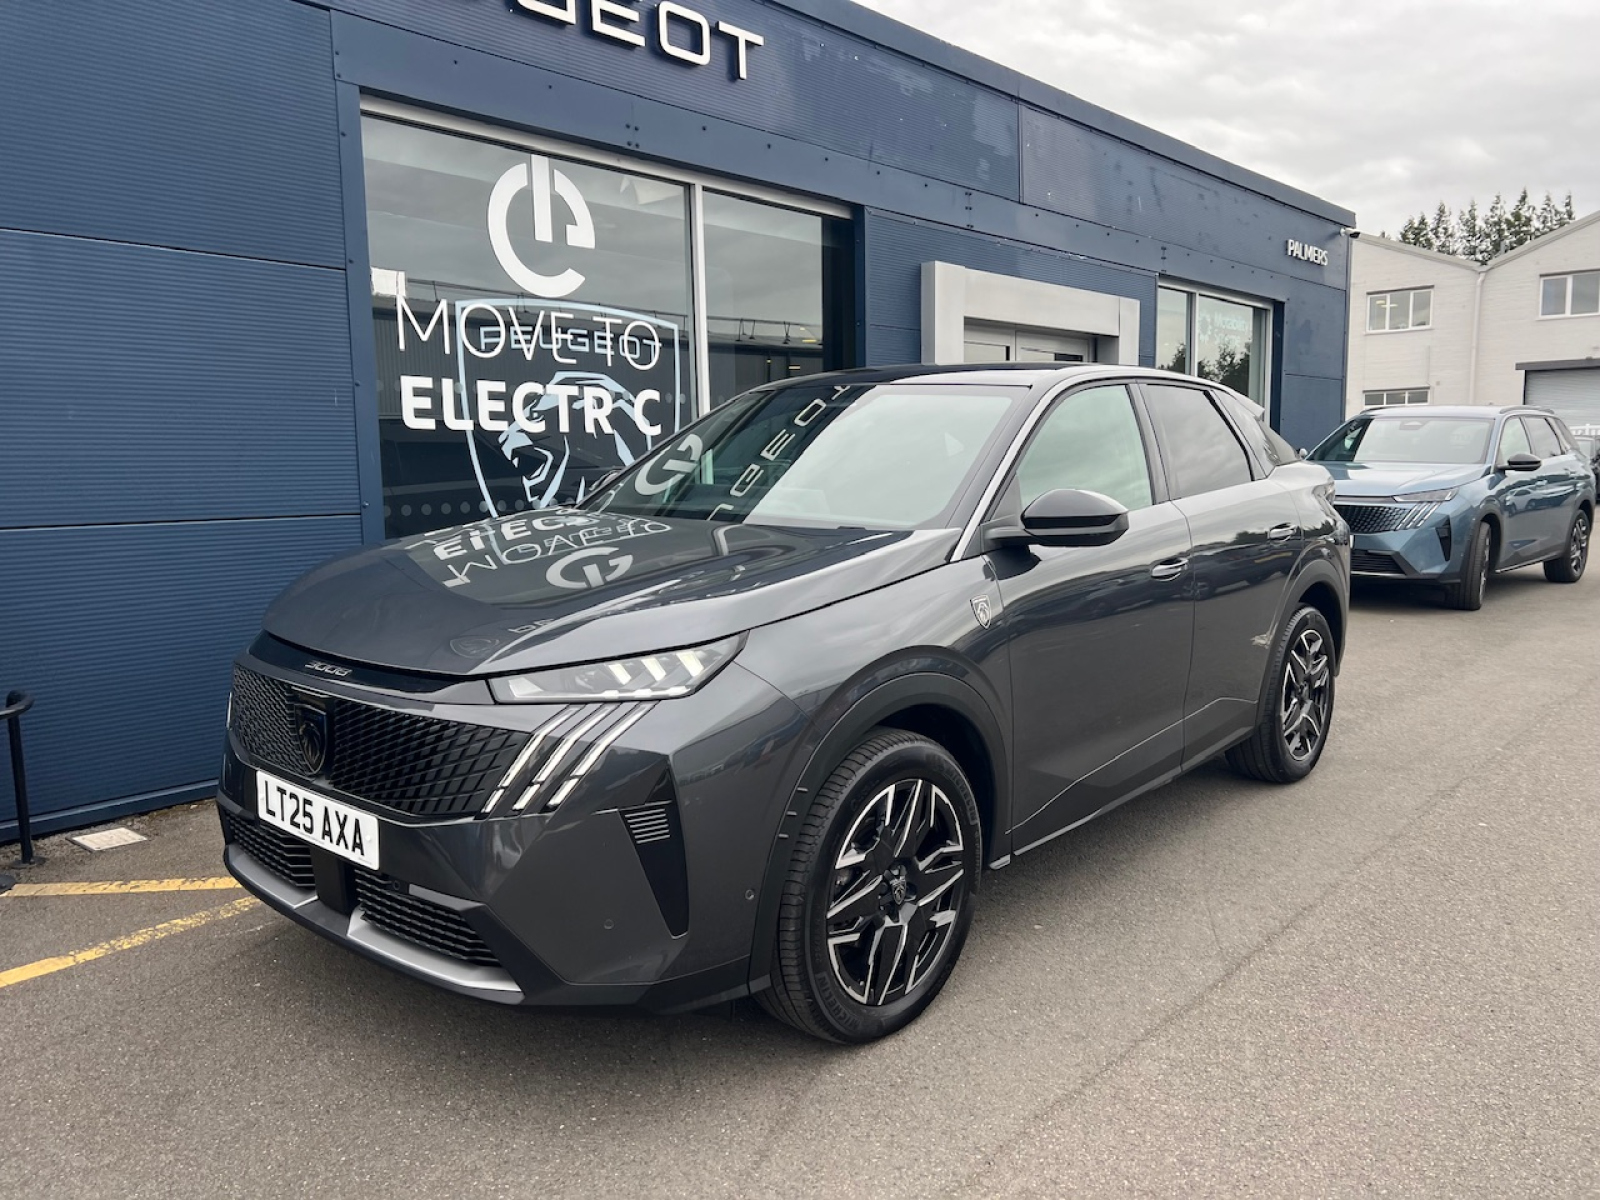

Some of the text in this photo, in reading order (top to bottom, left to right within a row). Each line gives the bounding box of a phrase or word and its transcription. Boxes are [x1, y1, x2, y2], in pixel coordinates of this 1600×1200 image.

[1286, 239, 1329, 266] PALMERS
[396, 297, 660, 371] MOVE TO
[479, 325, 662, 361] PEUGEOT
[400, 375, 662, 436] ELECTRC
[304, 660, 353, 677] 3008
[264, 779, 366, 857] LT25 AXA
